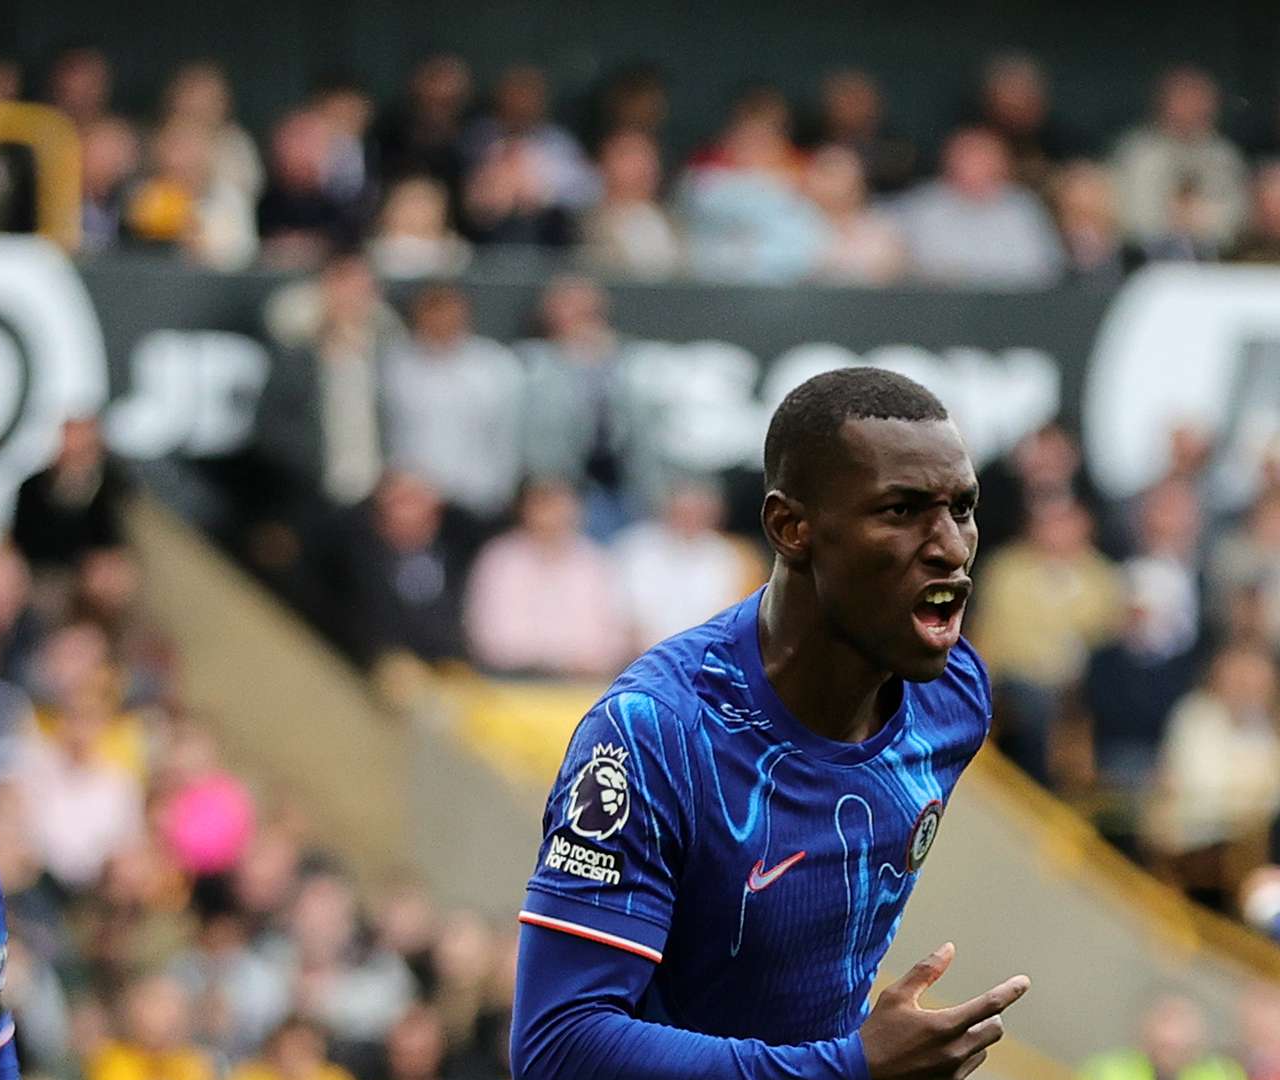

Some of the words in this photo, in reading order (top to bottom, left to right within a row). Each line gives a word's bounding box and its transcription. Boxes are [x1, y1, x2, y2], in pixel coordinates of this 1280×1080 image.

[545, 850, 566, 870] for
[563, 858, 621, 885] racism
[550, 834, 571, 856] No
[570, 844, 615, 869] room
